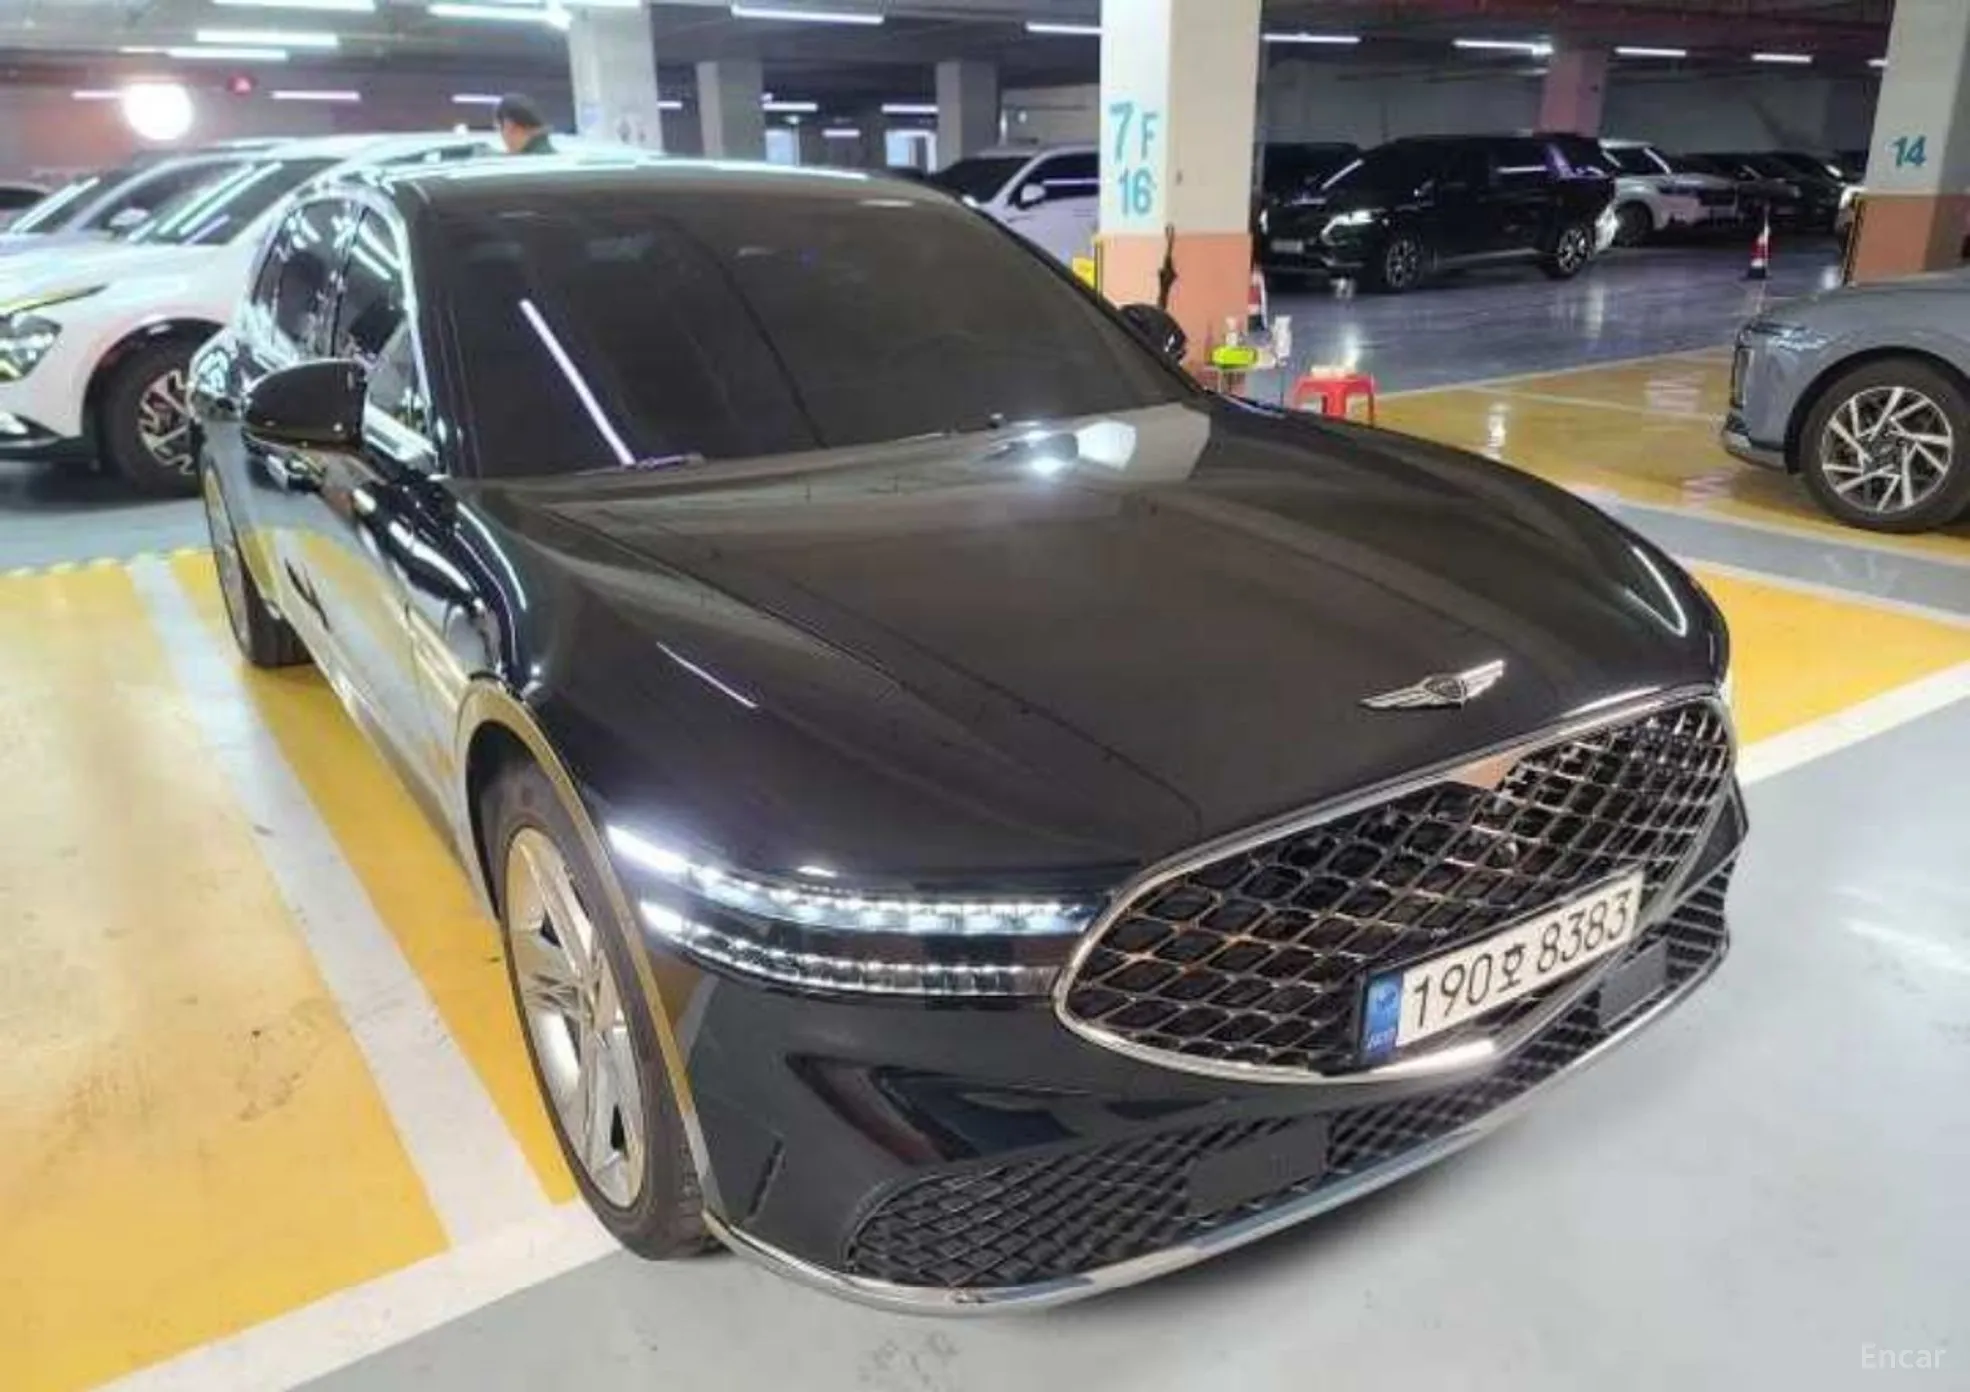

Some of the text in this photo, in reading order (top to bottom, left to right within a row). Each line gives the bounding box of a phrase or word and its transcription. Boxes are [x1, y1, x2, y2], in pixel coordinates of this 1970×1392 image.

[1890, 135, 1928, 168] 14
[1118, 167, 1153, 215] 16
[1536, 888, 1632, 974] 8383
